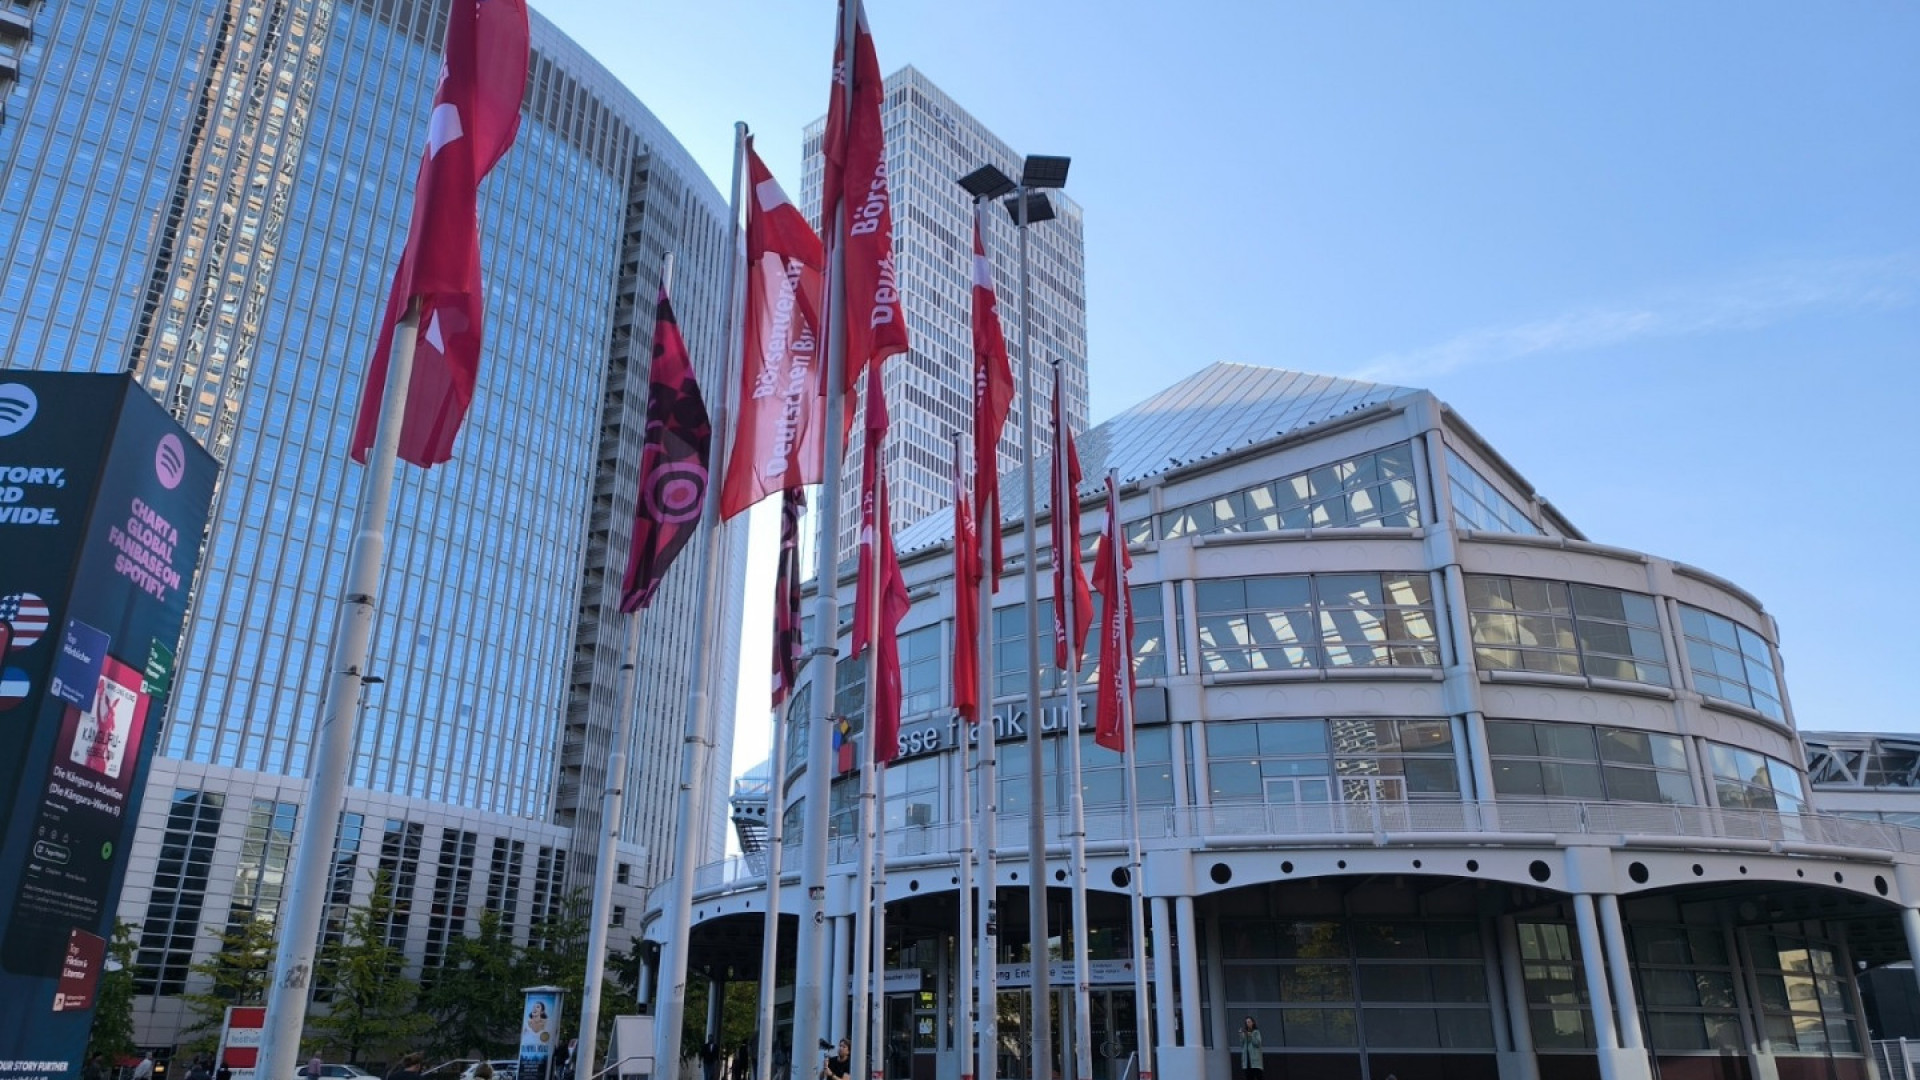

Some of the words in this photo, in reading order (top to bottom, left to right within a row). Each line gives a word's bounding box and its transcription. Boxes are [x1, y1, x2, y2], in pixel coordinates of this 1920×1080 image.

[127, 517, 173, 564] GLOBAL
[131, 497, 170, 539] CHART
[168, 528, 178, 547] A
[108, 525, 165, 578] FANBASE
[162, 567, 181, 590] ON
[114, 554, 165, 602] SPOTIFY.
[898, 727, 937, 757] sse
[53, 765, 66, 779] Die
